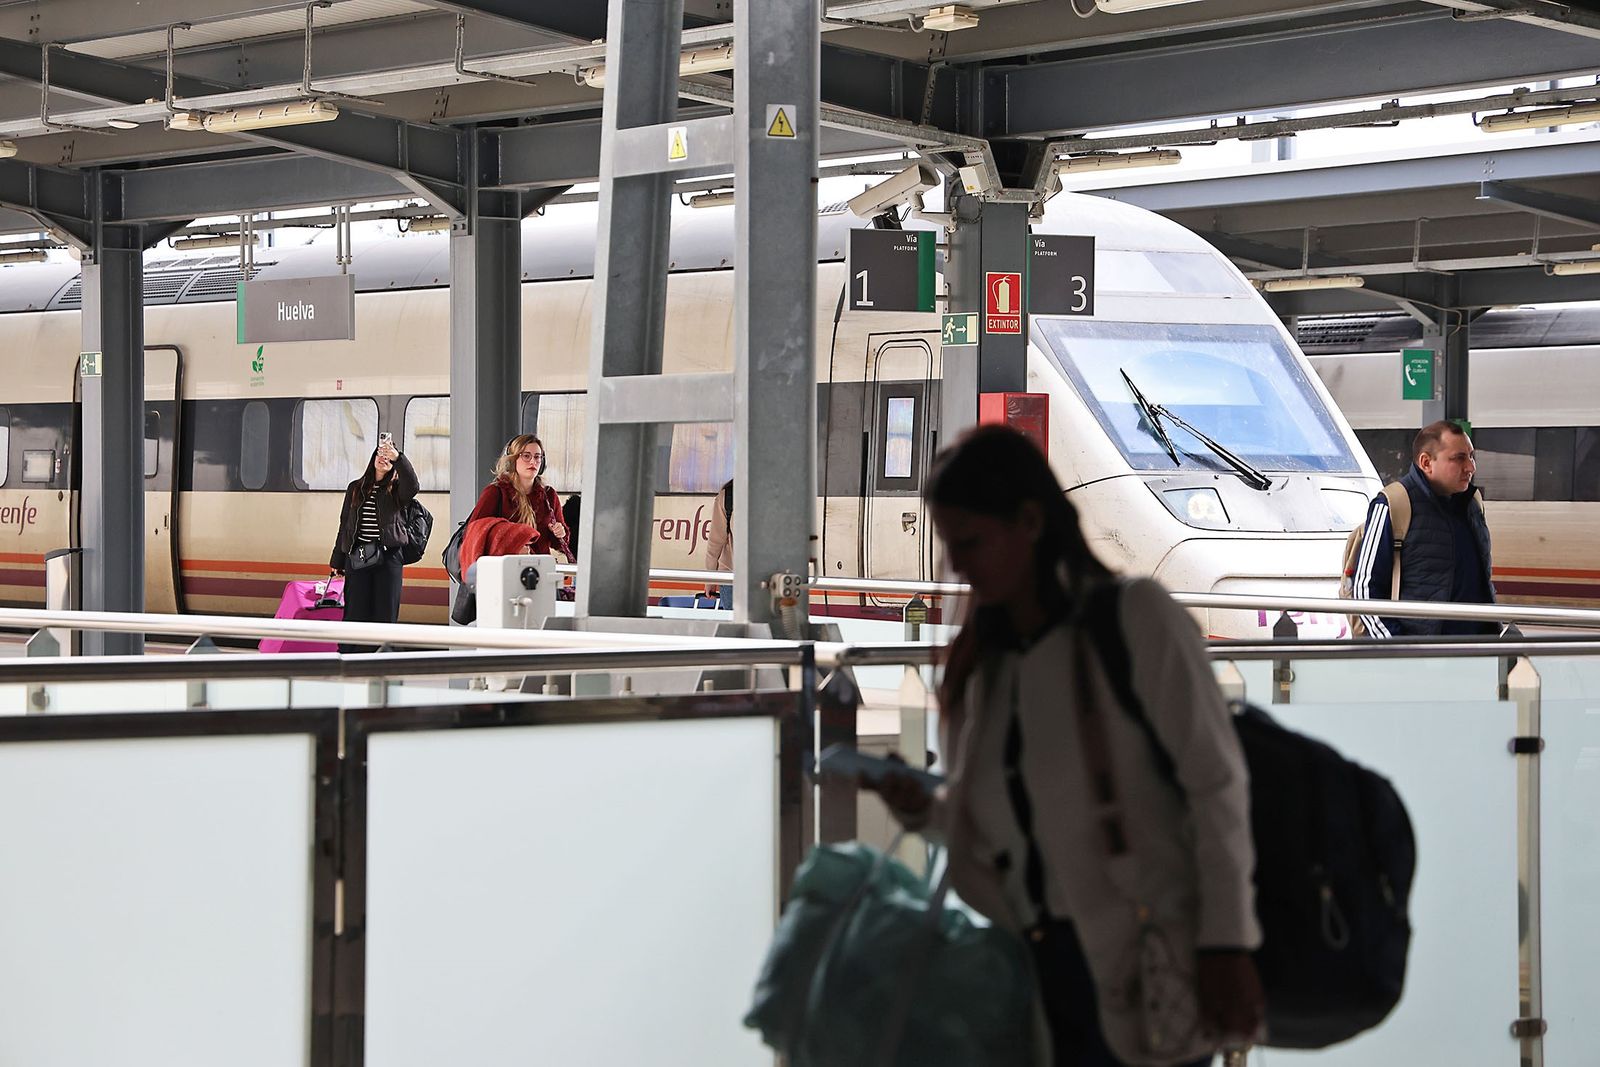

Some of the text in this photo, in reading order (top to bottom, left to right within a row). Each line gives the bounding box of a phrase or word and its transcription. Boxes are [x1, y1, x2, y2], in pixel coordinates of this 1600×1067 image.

[905, 233, 918, 243] Vía
[1034, 239, 1046, 248] Vía
[855, 269, 874, 307] 1
[1070, 275, 1087, 312] 3
[277, 300, 315, 321] Huelva
[988, 319, 1019, 330] EXTINTOR
[0, 495, 37, 536] enfe
